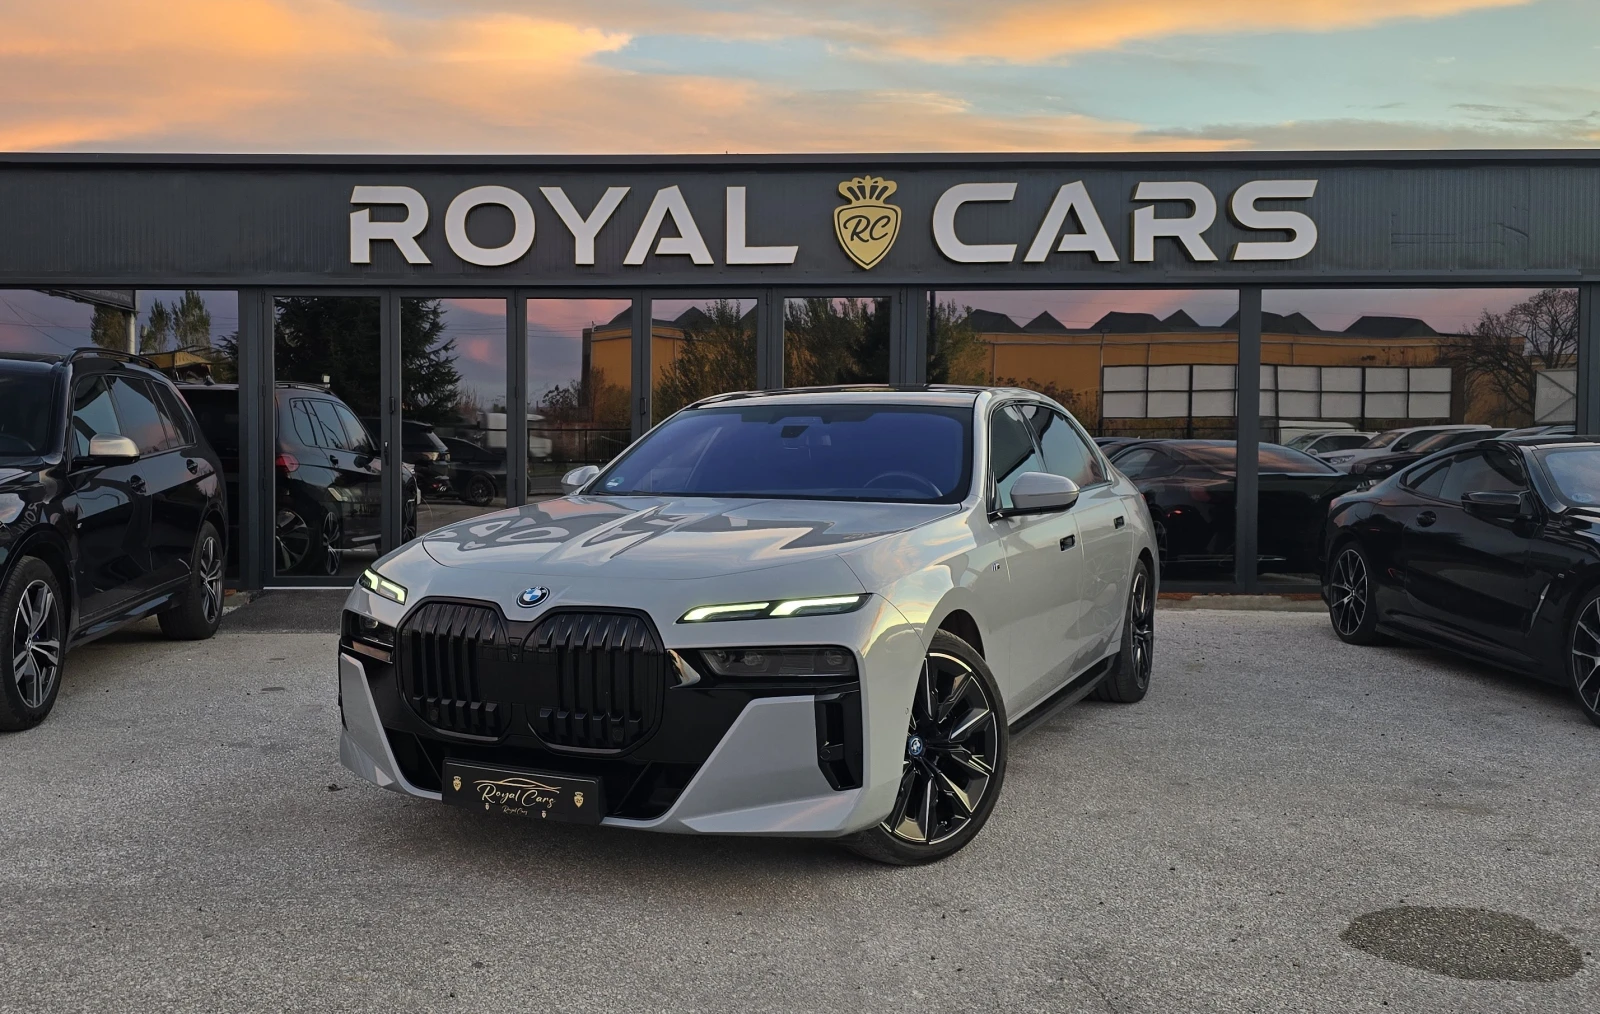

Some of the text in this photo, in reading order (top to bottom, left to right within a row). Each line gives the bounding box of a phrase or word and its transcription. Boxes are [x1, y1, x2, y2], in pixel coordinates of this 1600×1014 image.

[350, 179, 1319, 266] ROYAL CARS
[843, 214, 891, 243] RC
[476, 783, 556, 809] Royal Cars
